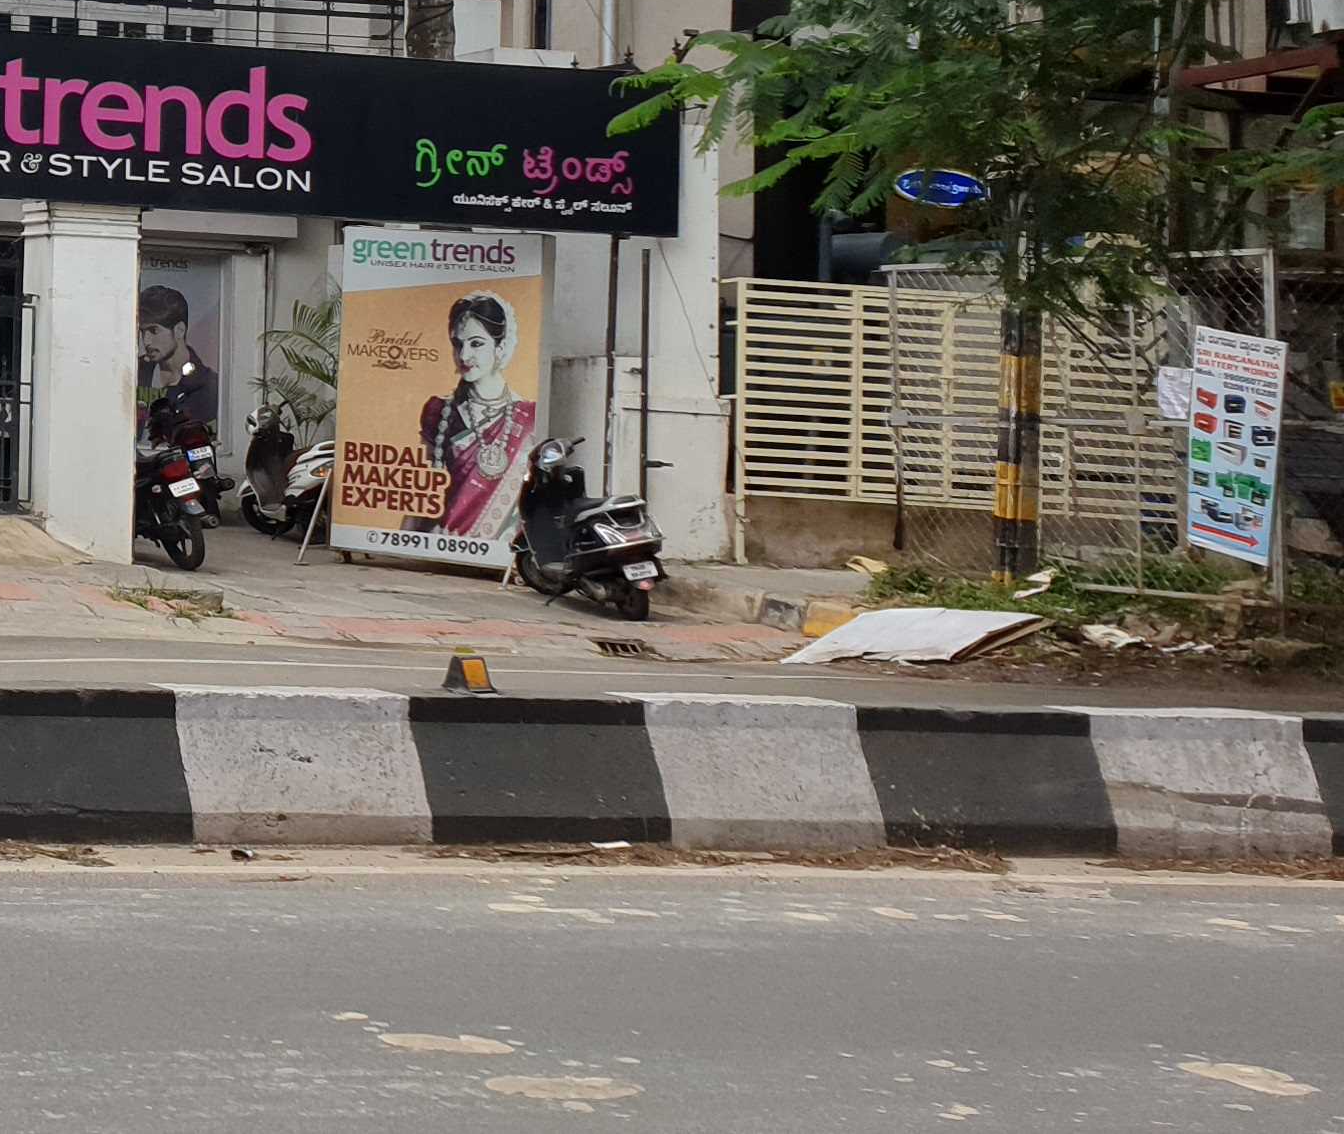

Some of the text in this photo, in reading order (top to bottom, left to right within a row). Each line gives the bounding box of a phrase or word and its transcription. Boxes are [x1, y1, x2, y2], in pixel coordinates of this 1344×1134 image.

[20, 152, 43, 174] &
[48, 152, 171, 183] STYLE
[180, 162, 312, 193] SALON
[352, 238, 515, 265] green trends
[370, 260, 407, 268] UNISEX
[444, 264, 478, 272] STYLE
[479, 265, 516, 273] SALON
[367, 328, 423, 346] Bridal
[347, 343, 439, 362] MAKEOVERS
[344, 441, 428, 468] BRIDAL
[342, 464, 447, 492] MAKEUP
[341, 485, 441, 515] EXPERTS
[381, 531, 489, 556] 78991 08909
